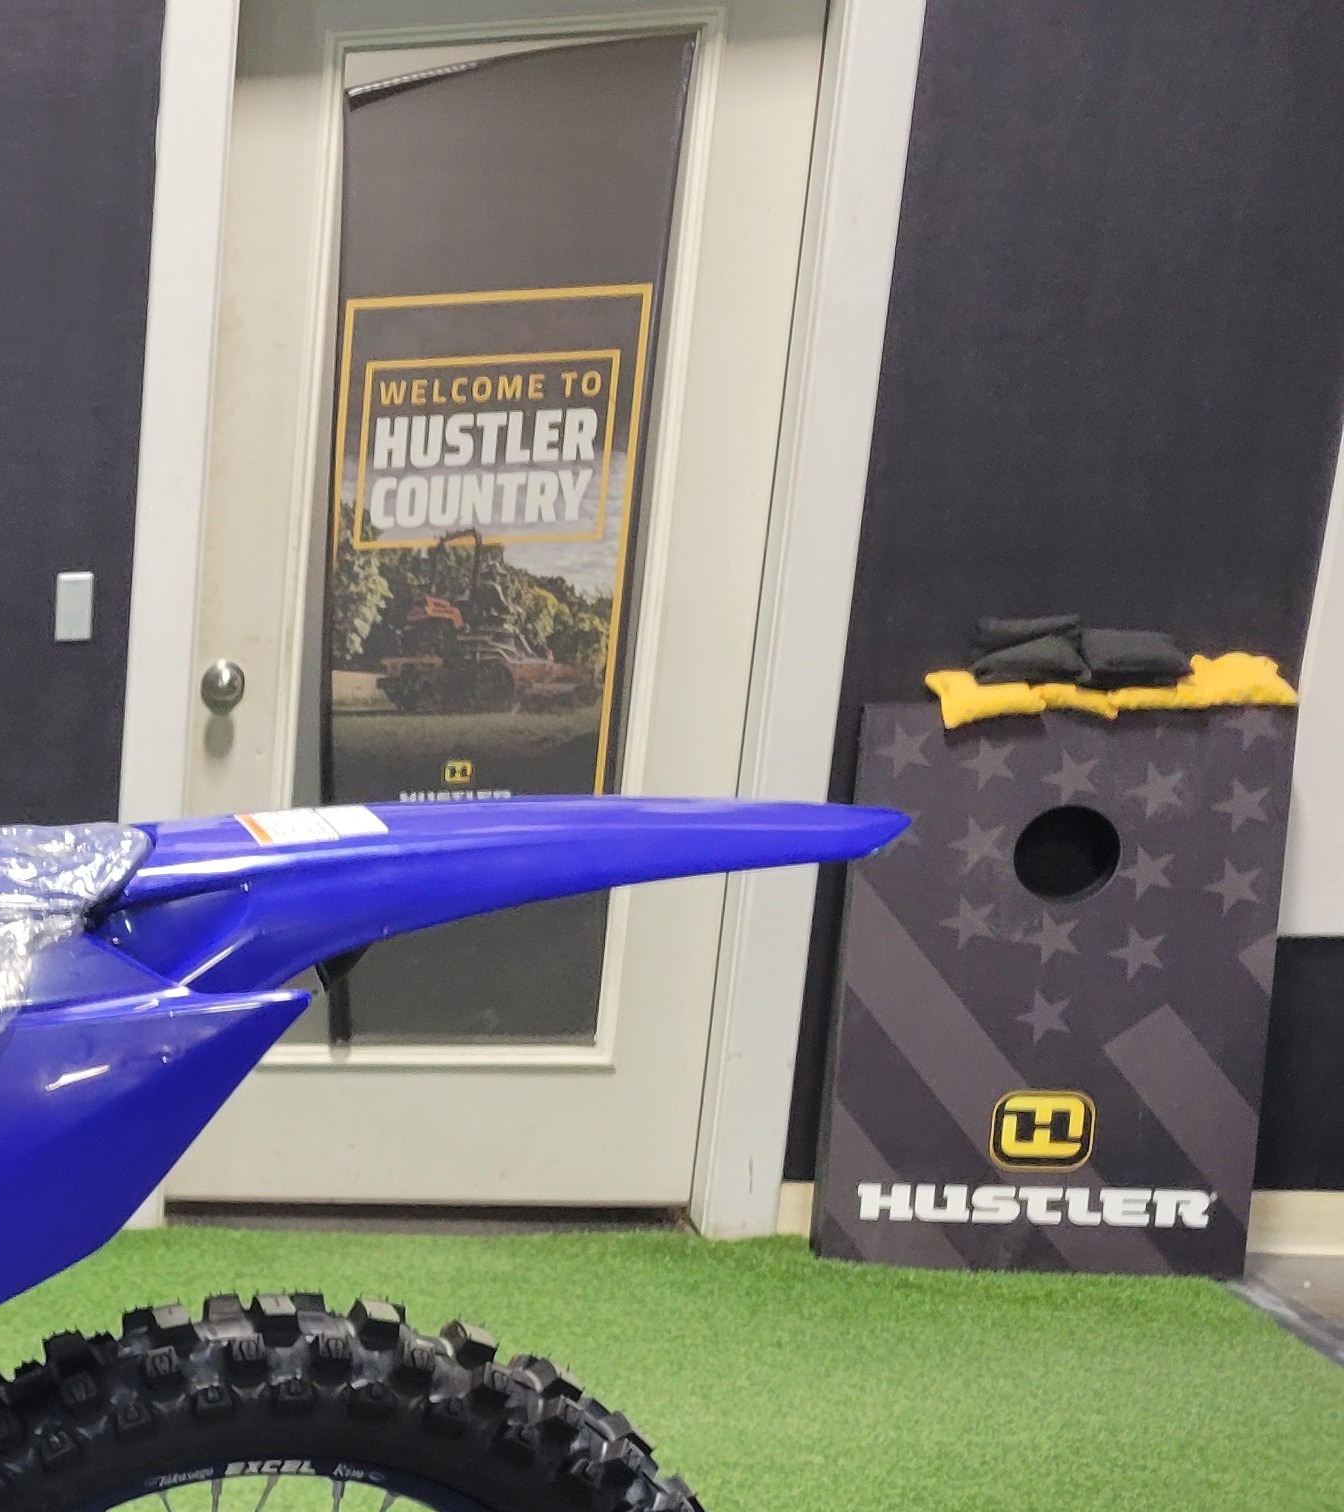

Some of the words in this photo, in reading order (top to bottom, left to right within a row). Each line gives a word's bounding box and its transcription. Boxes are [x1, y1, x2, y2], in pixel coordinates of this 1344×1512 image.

[379, 374, 546, 406] WELCOME
[561, 370, 602, 399] TO
[373, 407, 598, 470] HUSTLER
[369, 469, 594, 530] COUNTRY
[857, 1182, 1212, 1230] HUSTLER
[224, 1459, 316, 1476] EXCEL
